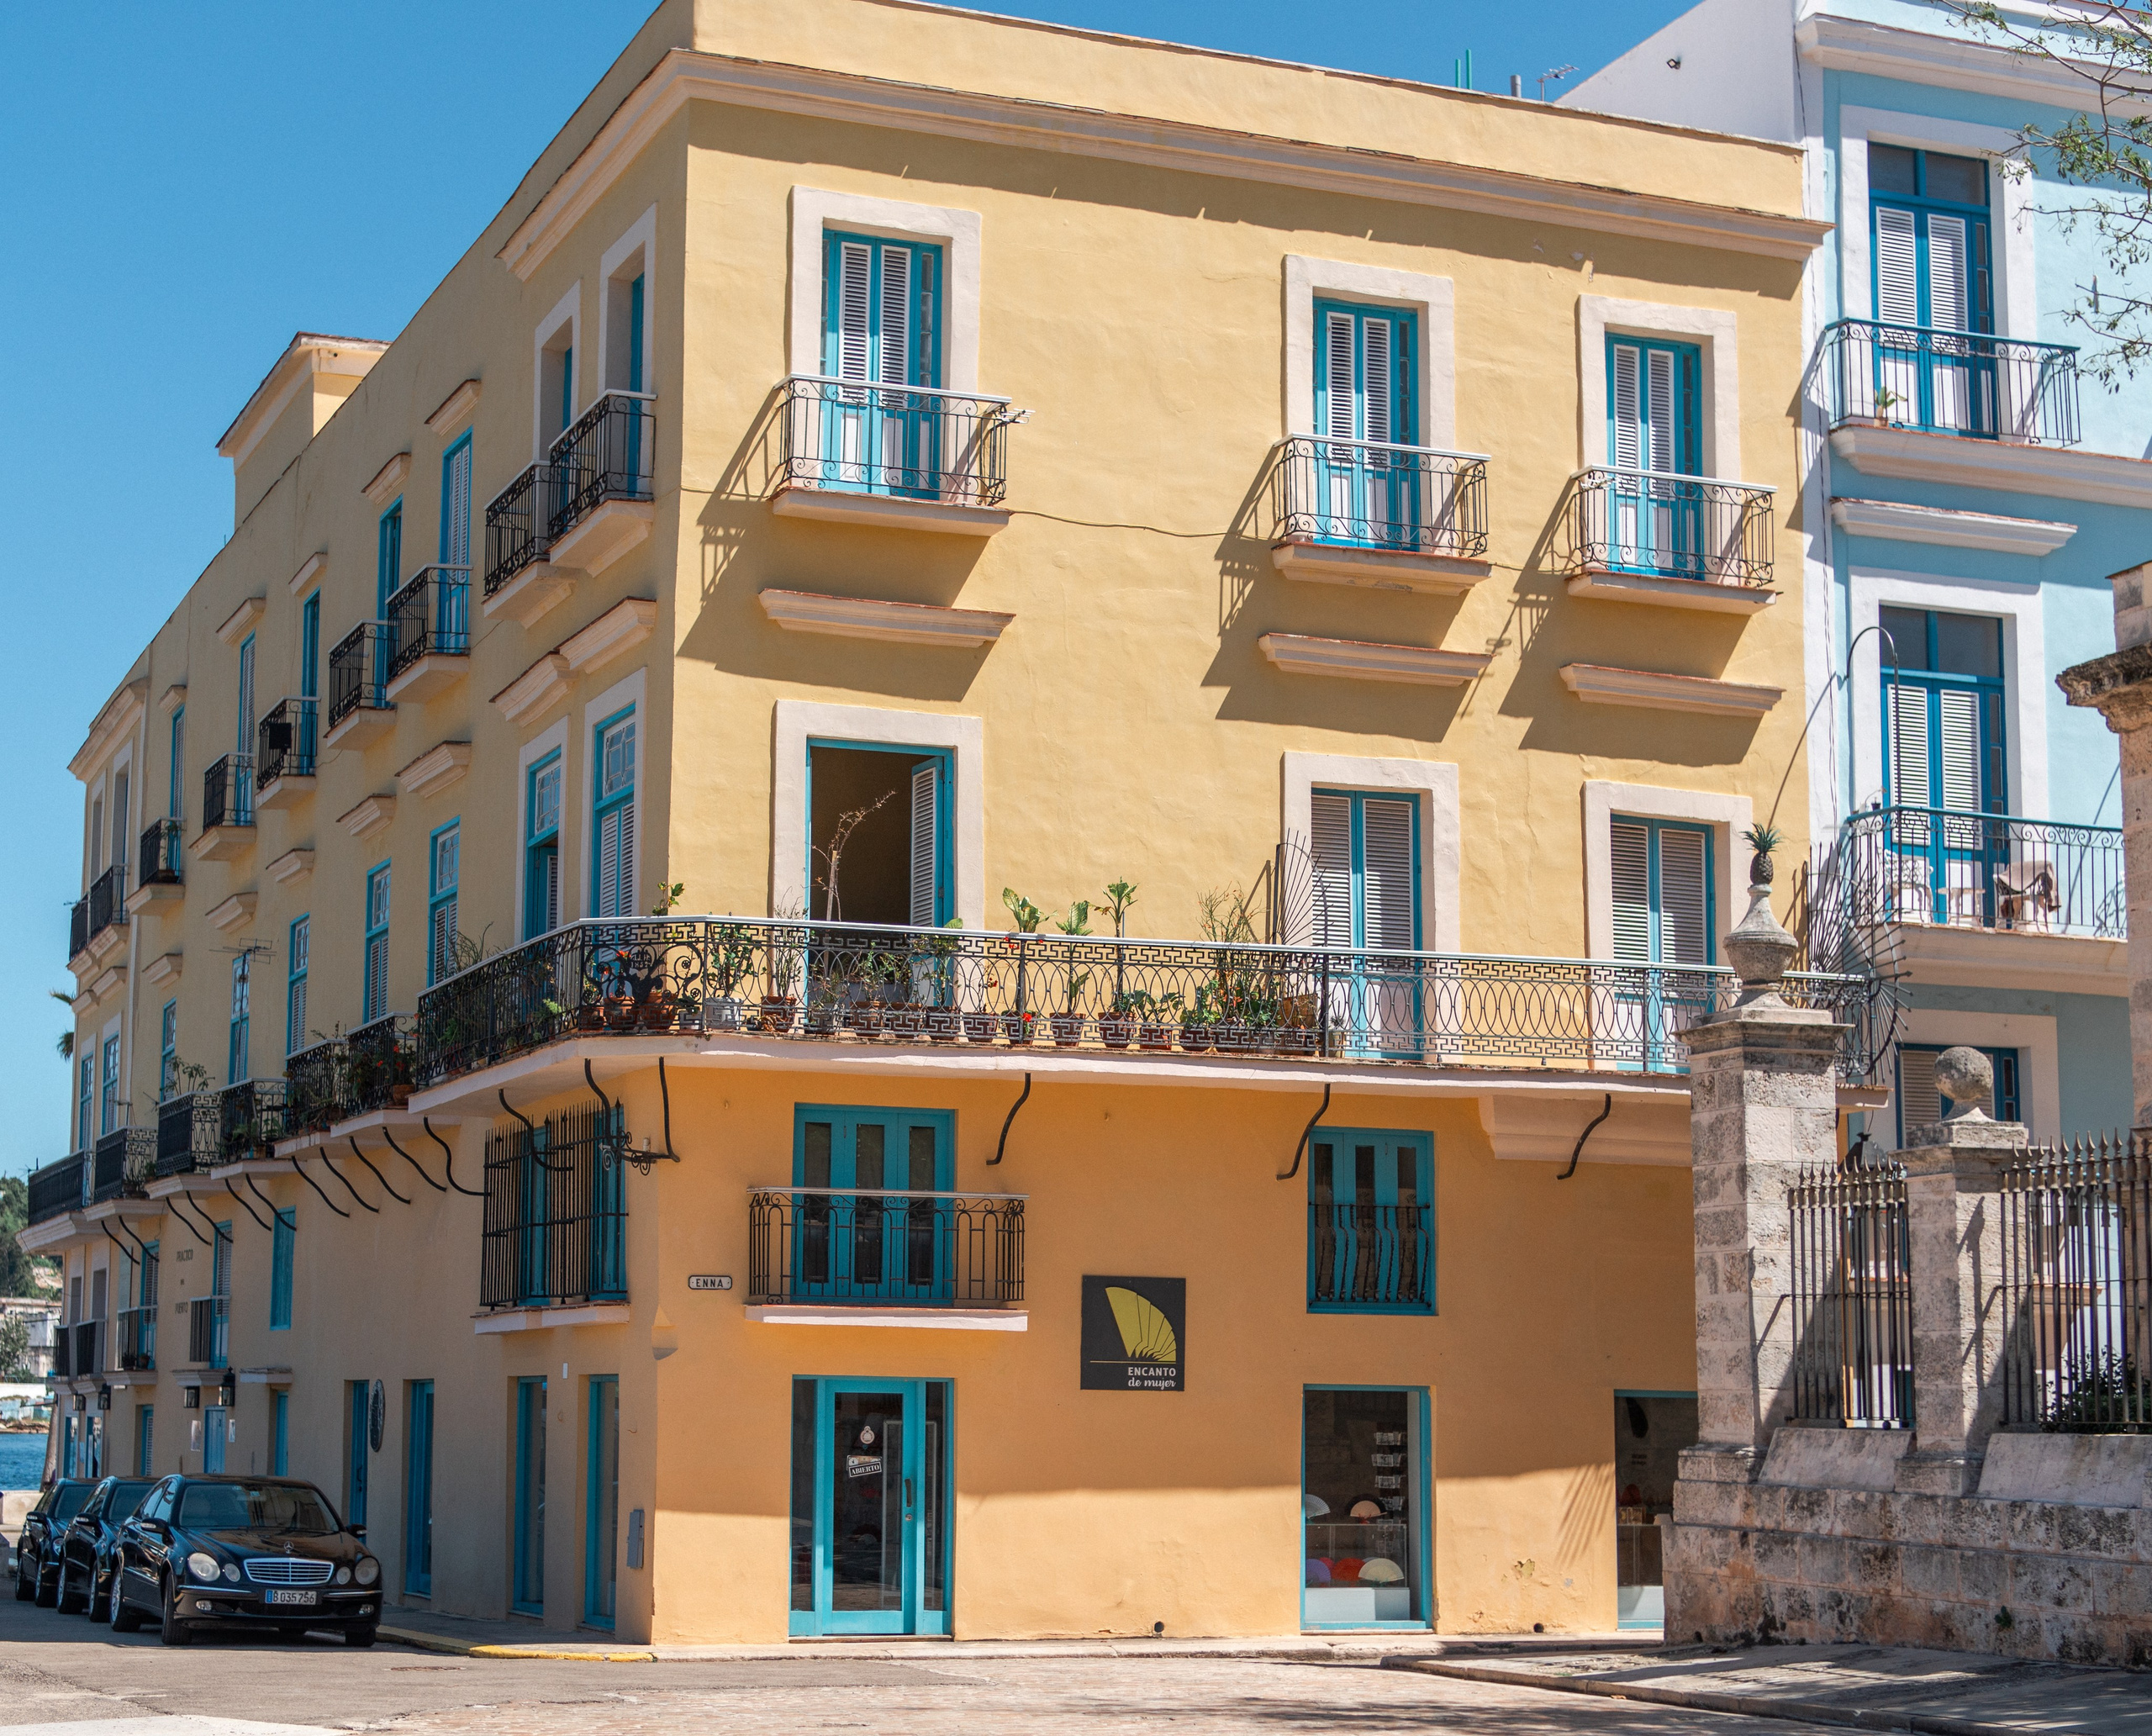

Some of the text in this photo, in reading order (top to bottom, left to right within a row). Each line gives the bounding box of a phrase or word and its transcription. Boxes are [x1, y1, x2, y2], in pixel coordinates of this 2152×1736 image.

[696, 1279, 724, 1287] ENNA
[1127, 1366, 1176, 1377] ENCANTO
[1127, 1376, 1177, 1390] de mujer
[851, 1464, 880, 1475] ABIERTO
